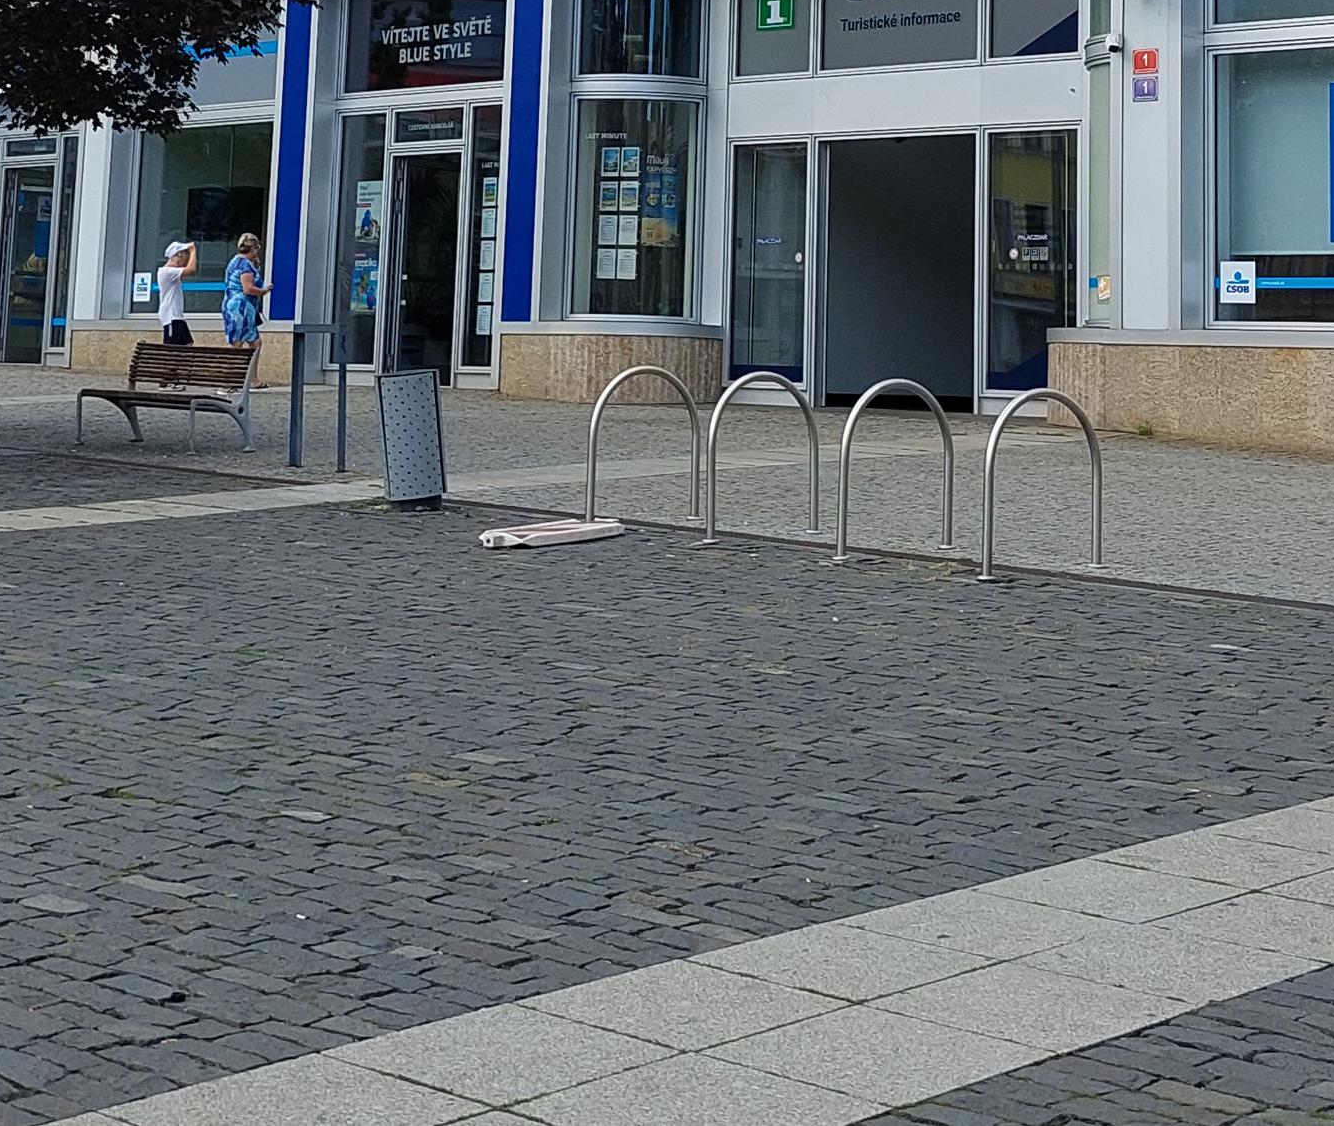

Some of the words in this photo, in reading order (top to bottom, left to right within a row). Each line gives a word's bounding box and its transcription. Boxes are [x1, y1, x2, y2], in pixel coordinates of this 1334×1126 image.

[840, 13, 897, 32] Turistické
[900, 10, 961, 27] informace
[381, 26, 430, 45] VÍTEJTE
[433, 23, 450, 40] VE
[453, 14, 492, 38] SVĚTĚ
[398, 46, 431, 64] BLUE
[433, 42, 472, 61] STYLE
[1142, 53, 1148, 67] 1
[1142, 81, 1148, 94] 1
[601, 132, 627, 140] MINUTE
[1226, 284, 1250, 294] ČSOB
